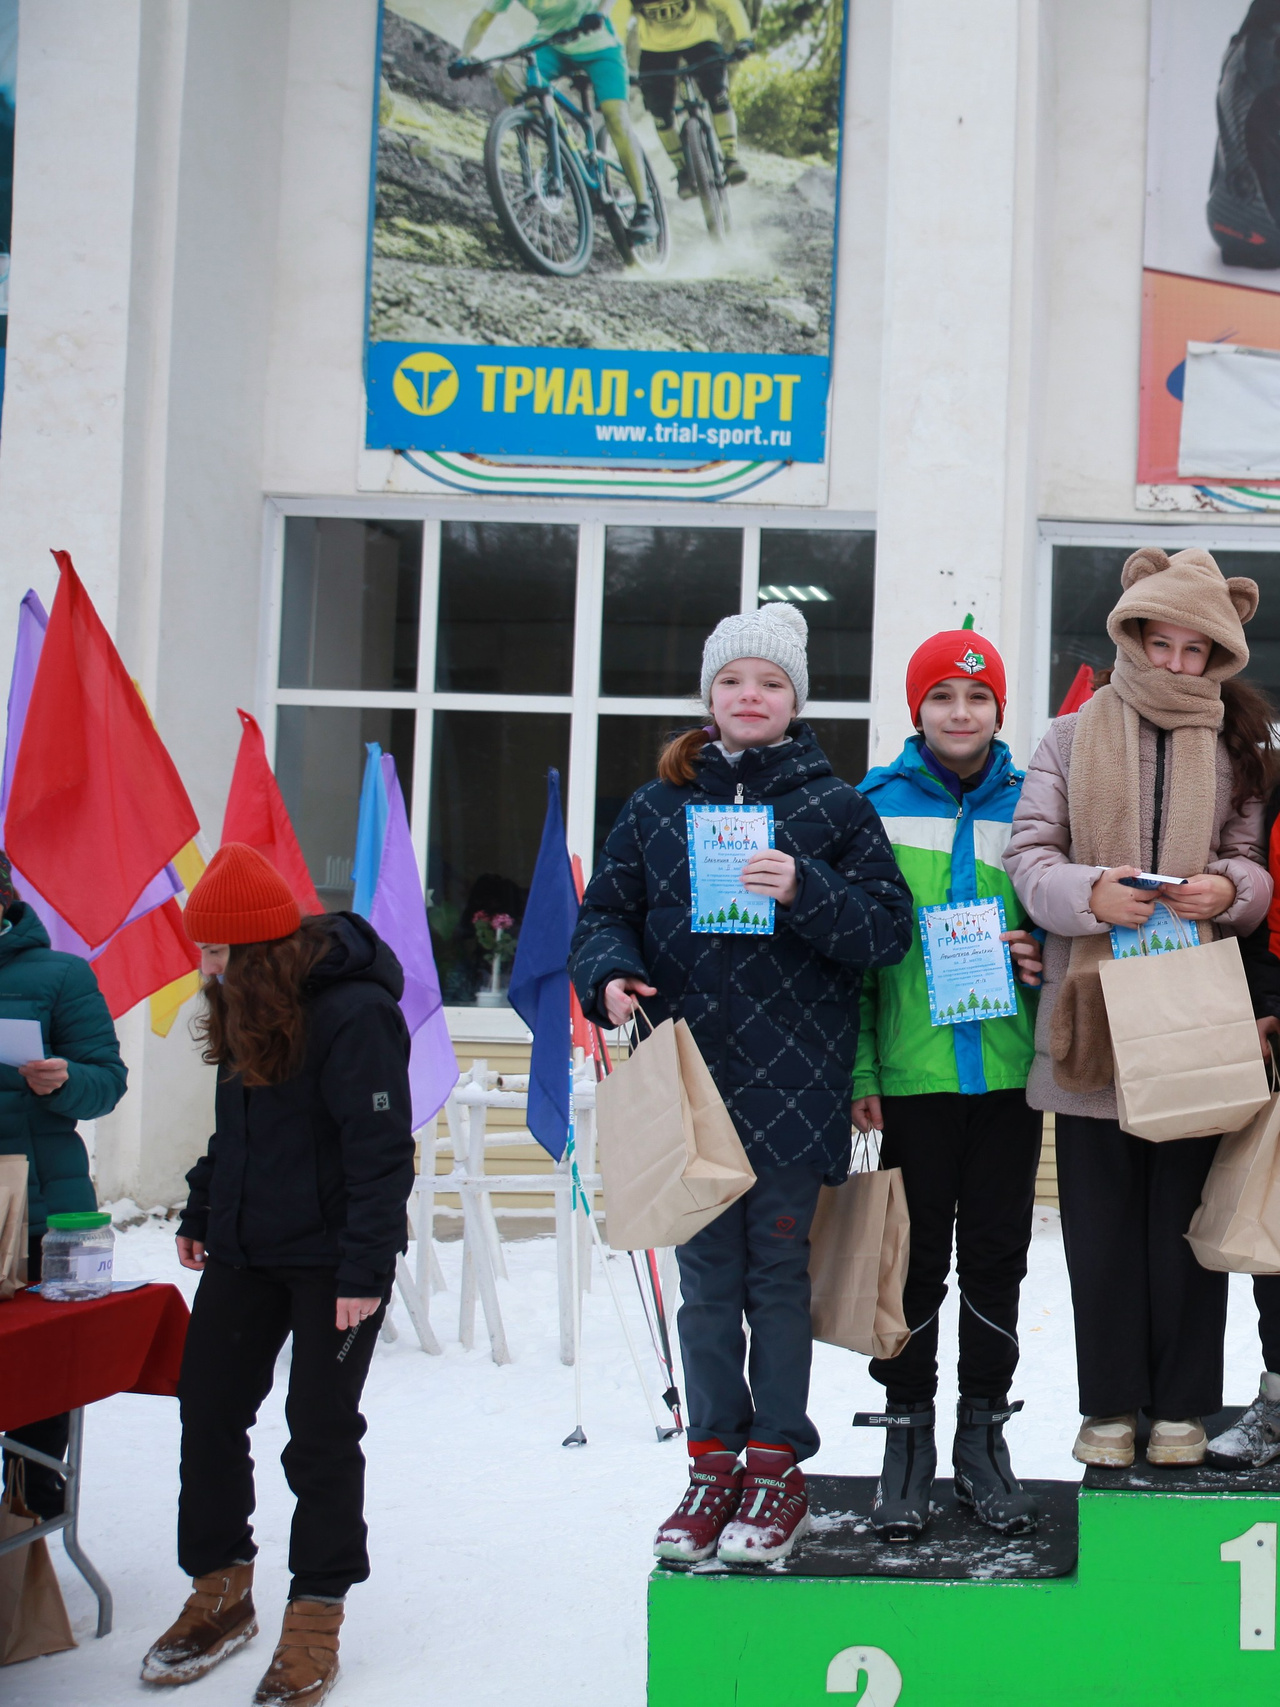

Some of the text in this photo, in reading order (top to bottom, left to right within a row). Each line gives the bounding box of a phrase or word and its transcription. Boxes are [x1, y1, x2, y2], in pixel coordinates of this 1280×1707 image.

[595, 423, 792, 448] www.trial-sport.ru
[704, 840, 758, 850] ГРАМОТА
[937, 931, 992, 947] ГРАМОТА
[869, 1416, 911, 1424] SPINE
[754, 1477, 785, 1489] TOREAD
[1220, 1521, 1277, 1650] 1
